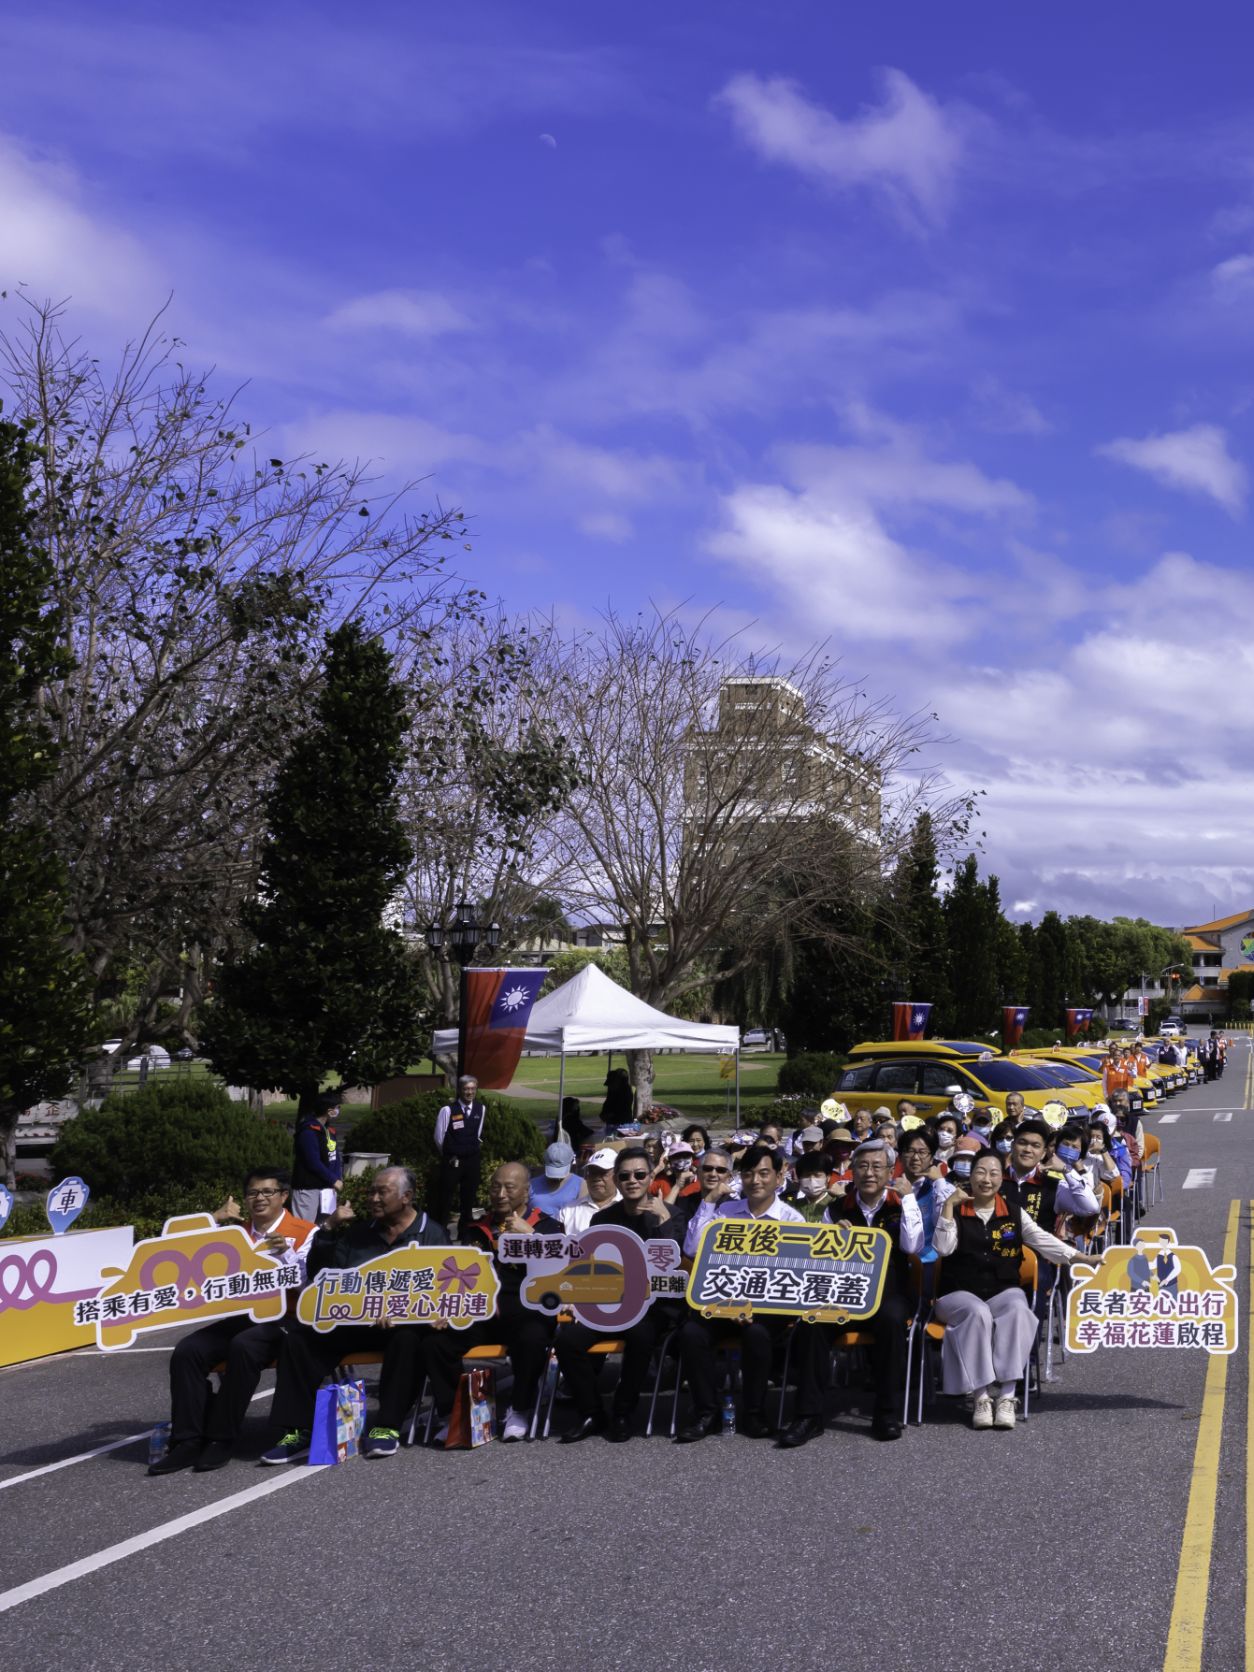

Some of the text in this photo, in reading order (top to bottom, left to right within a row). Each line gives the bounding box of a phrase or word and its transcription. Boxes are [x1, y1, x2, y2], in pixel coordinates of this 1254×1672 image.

[57, 1189, 78, 1214] 車
[503, 1239, 584, 1259] 運轉愛心
[716, 1224, 874, 1261] 最後一公尺
[647, 1245, 675, 1272] 零
[76, 1265, 300, 1323] 搭乘有愛，行動無礙
[316, 1267, 434, 1295] 行動傳遞愛
[650, 1276, 686, 1293] 距離
[703, 1268, 868, 1306] 交通全覆蓋
[362, 1293, 488, 1319] 用愛心相連
[1079, 1291, 1225, 1316] 長者安心出行
[1078, 1321, 1225, 1346] 幸福花蓮啟程
